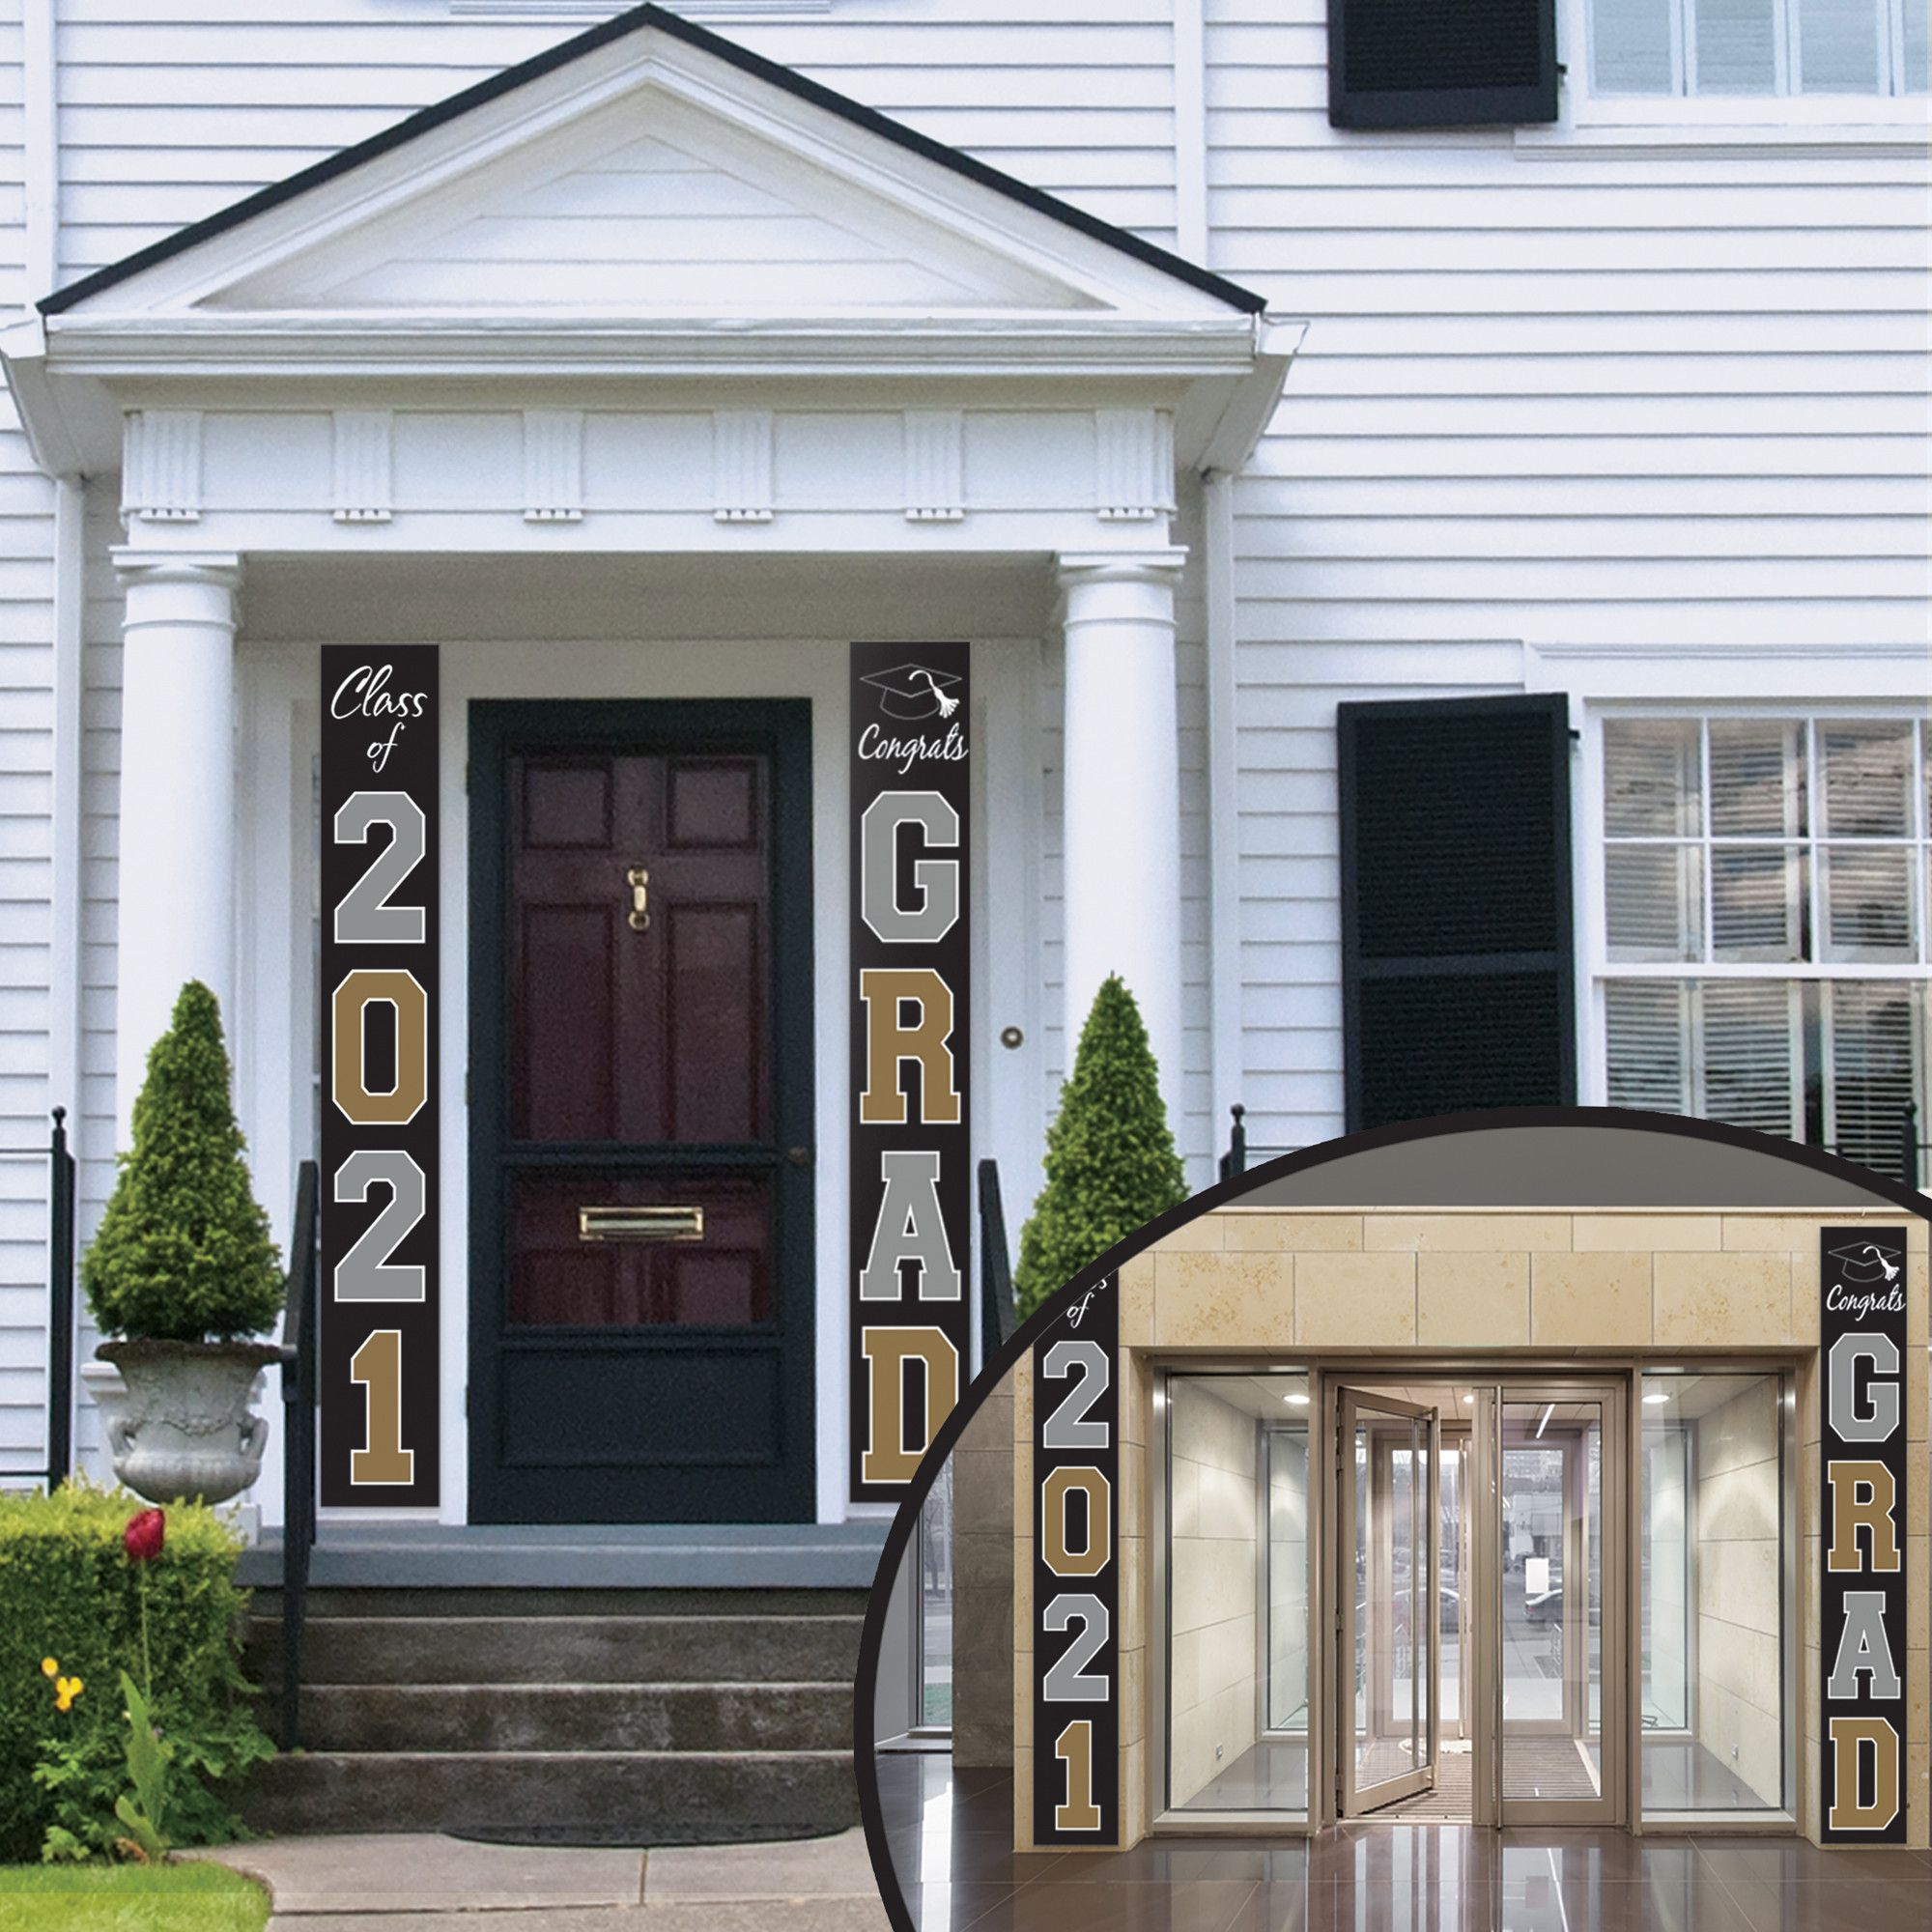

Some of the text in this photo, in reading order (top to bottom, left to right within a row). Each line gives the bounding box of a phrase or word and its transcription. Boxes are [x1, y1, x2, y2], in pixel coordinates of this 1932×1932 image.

[331, 665, 428, 720] Class
[366, 722, 406, 773] of
[858, 723, 969, 775] Congrats
[332, 790, 427, 1486] 2021
[860, 790, 961, 1484] GRAD
[1066, 1292, 1095, 1329] of
[1826, 1284, 1907, 1321] Congrats
[1041, 1340, 1110, 1831] 2021
[1828, 1332, 1901, 1831] GRAD
